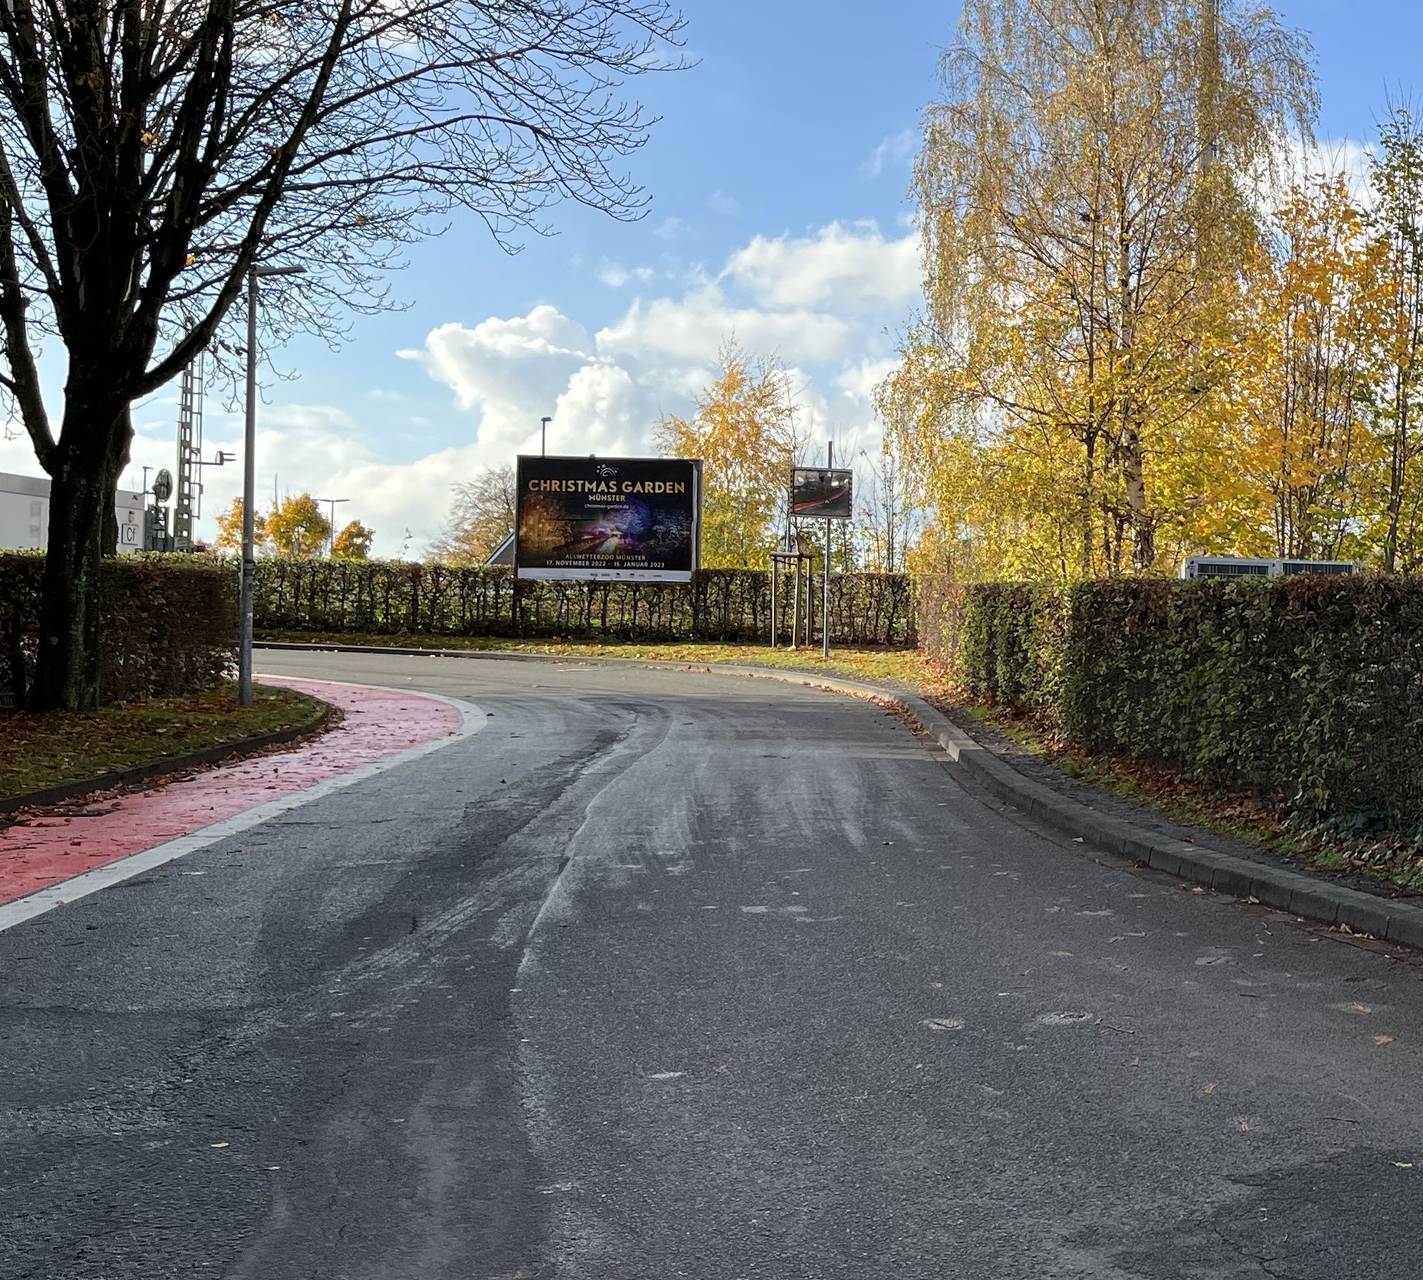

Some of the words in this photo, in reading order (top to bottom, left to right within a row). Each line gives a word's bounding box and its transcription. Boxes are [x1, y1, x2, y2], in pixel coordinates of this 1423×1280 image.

[528, 479, 617, 493] CHRISTMAS
[621, 481, 686, 494] GARDEN
[588, 494, 626, 502] MÜNSTER
